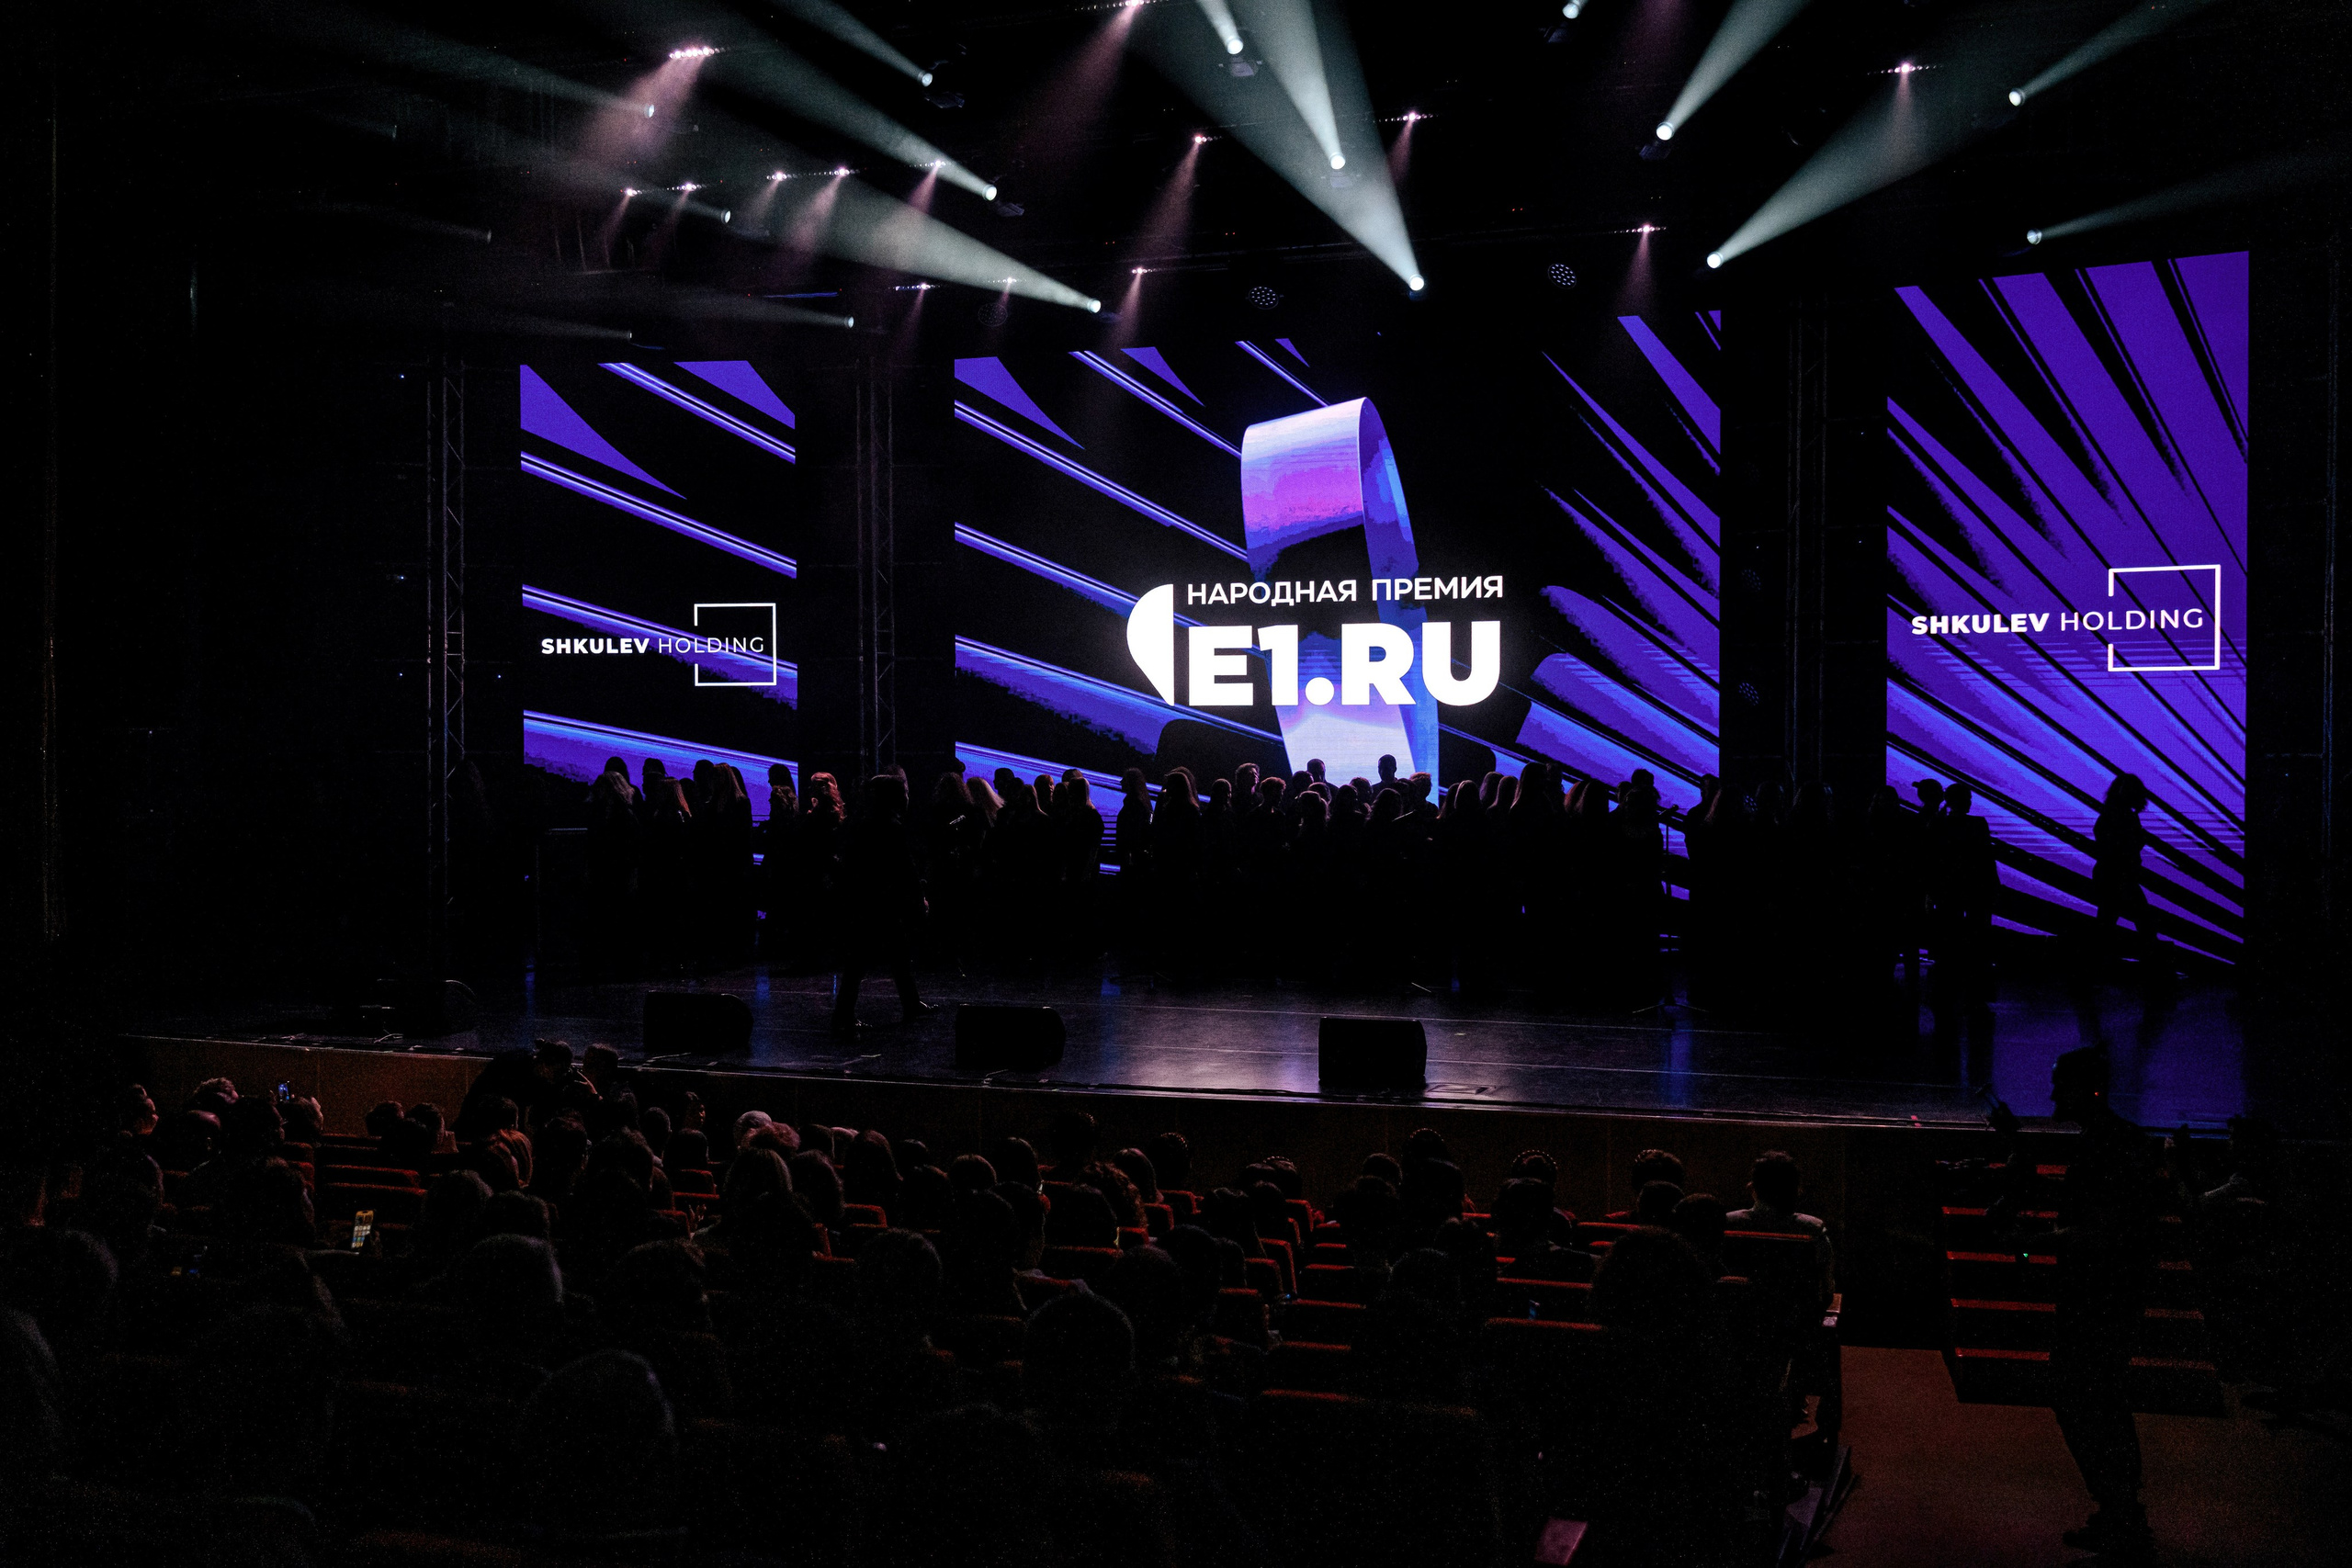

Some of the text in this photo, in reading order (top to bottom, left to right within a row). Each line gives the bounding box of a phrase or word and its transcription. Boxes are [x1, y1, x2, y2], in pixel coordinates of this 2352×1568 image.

[1187, 575, 1503, 606] НАРОДНАЯ ПРЕМИЯ
[1911, 608, 2203, 635] SHKULEV HOLDING
[540, 637, 764, 654] SHKULEV HOLDING
[1188, 620, 1501, 706] E1.RU
